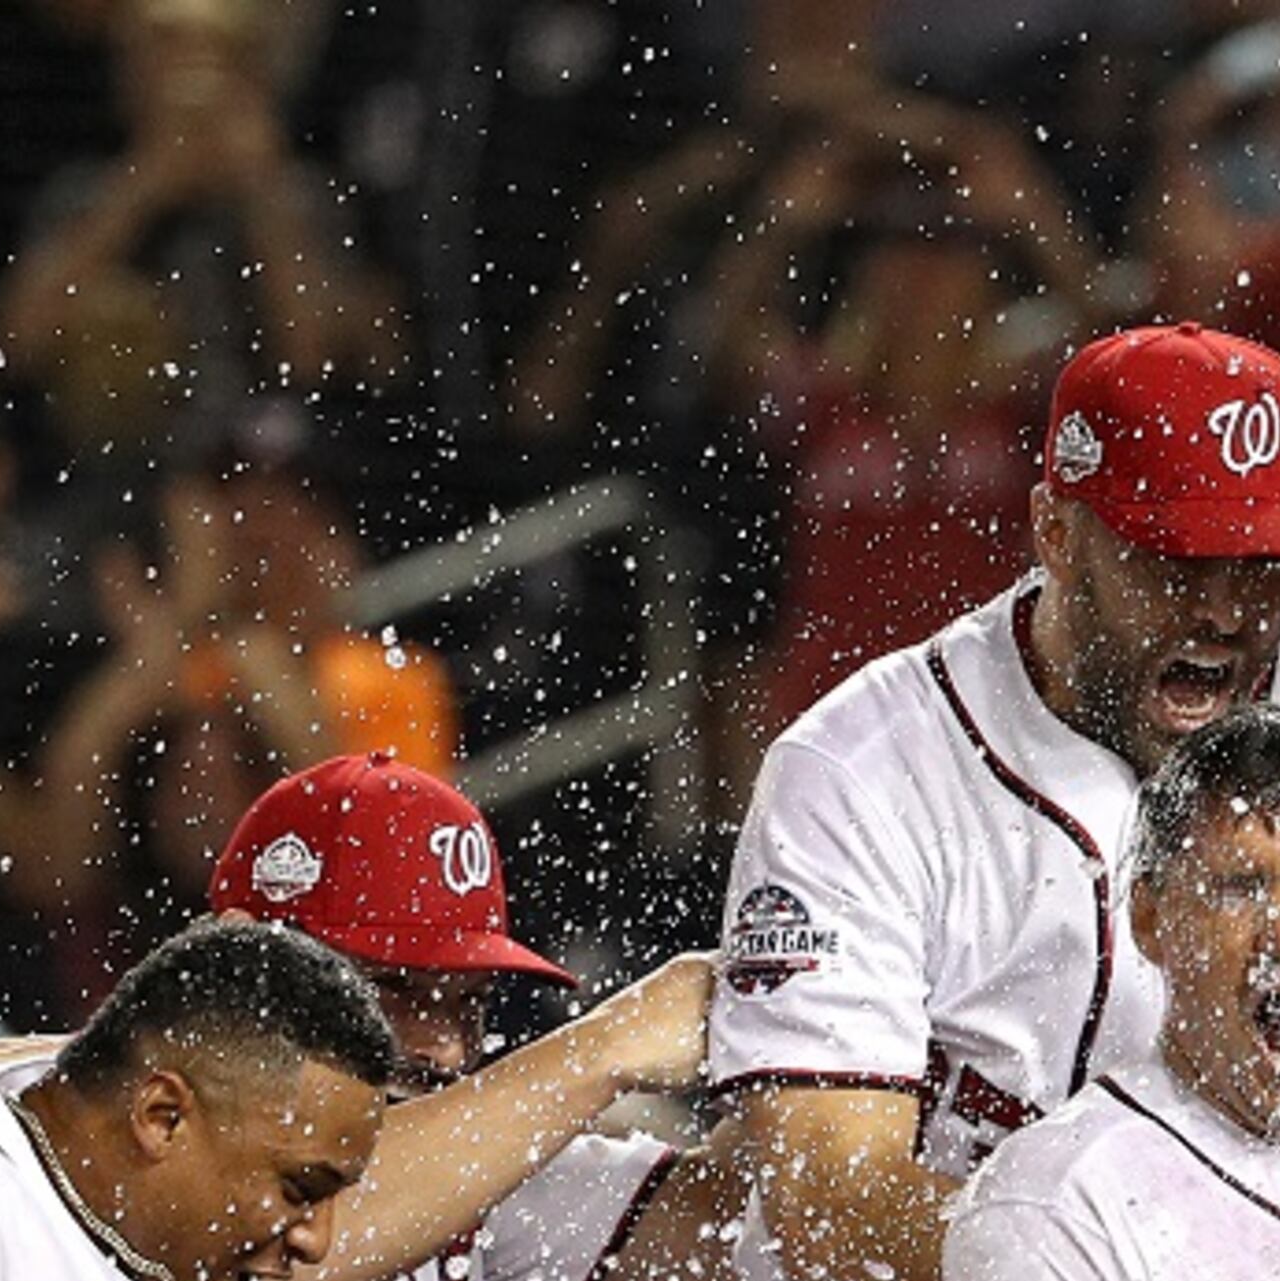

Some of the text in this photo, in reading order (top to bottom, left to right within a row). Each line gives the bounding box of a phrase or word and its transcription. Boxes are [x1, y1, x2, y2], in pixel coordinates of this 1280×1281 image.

[1207, 391, 1280, 478] W
[430, 822, 491, 896] W
[781, 929, 839, 954] GAME
